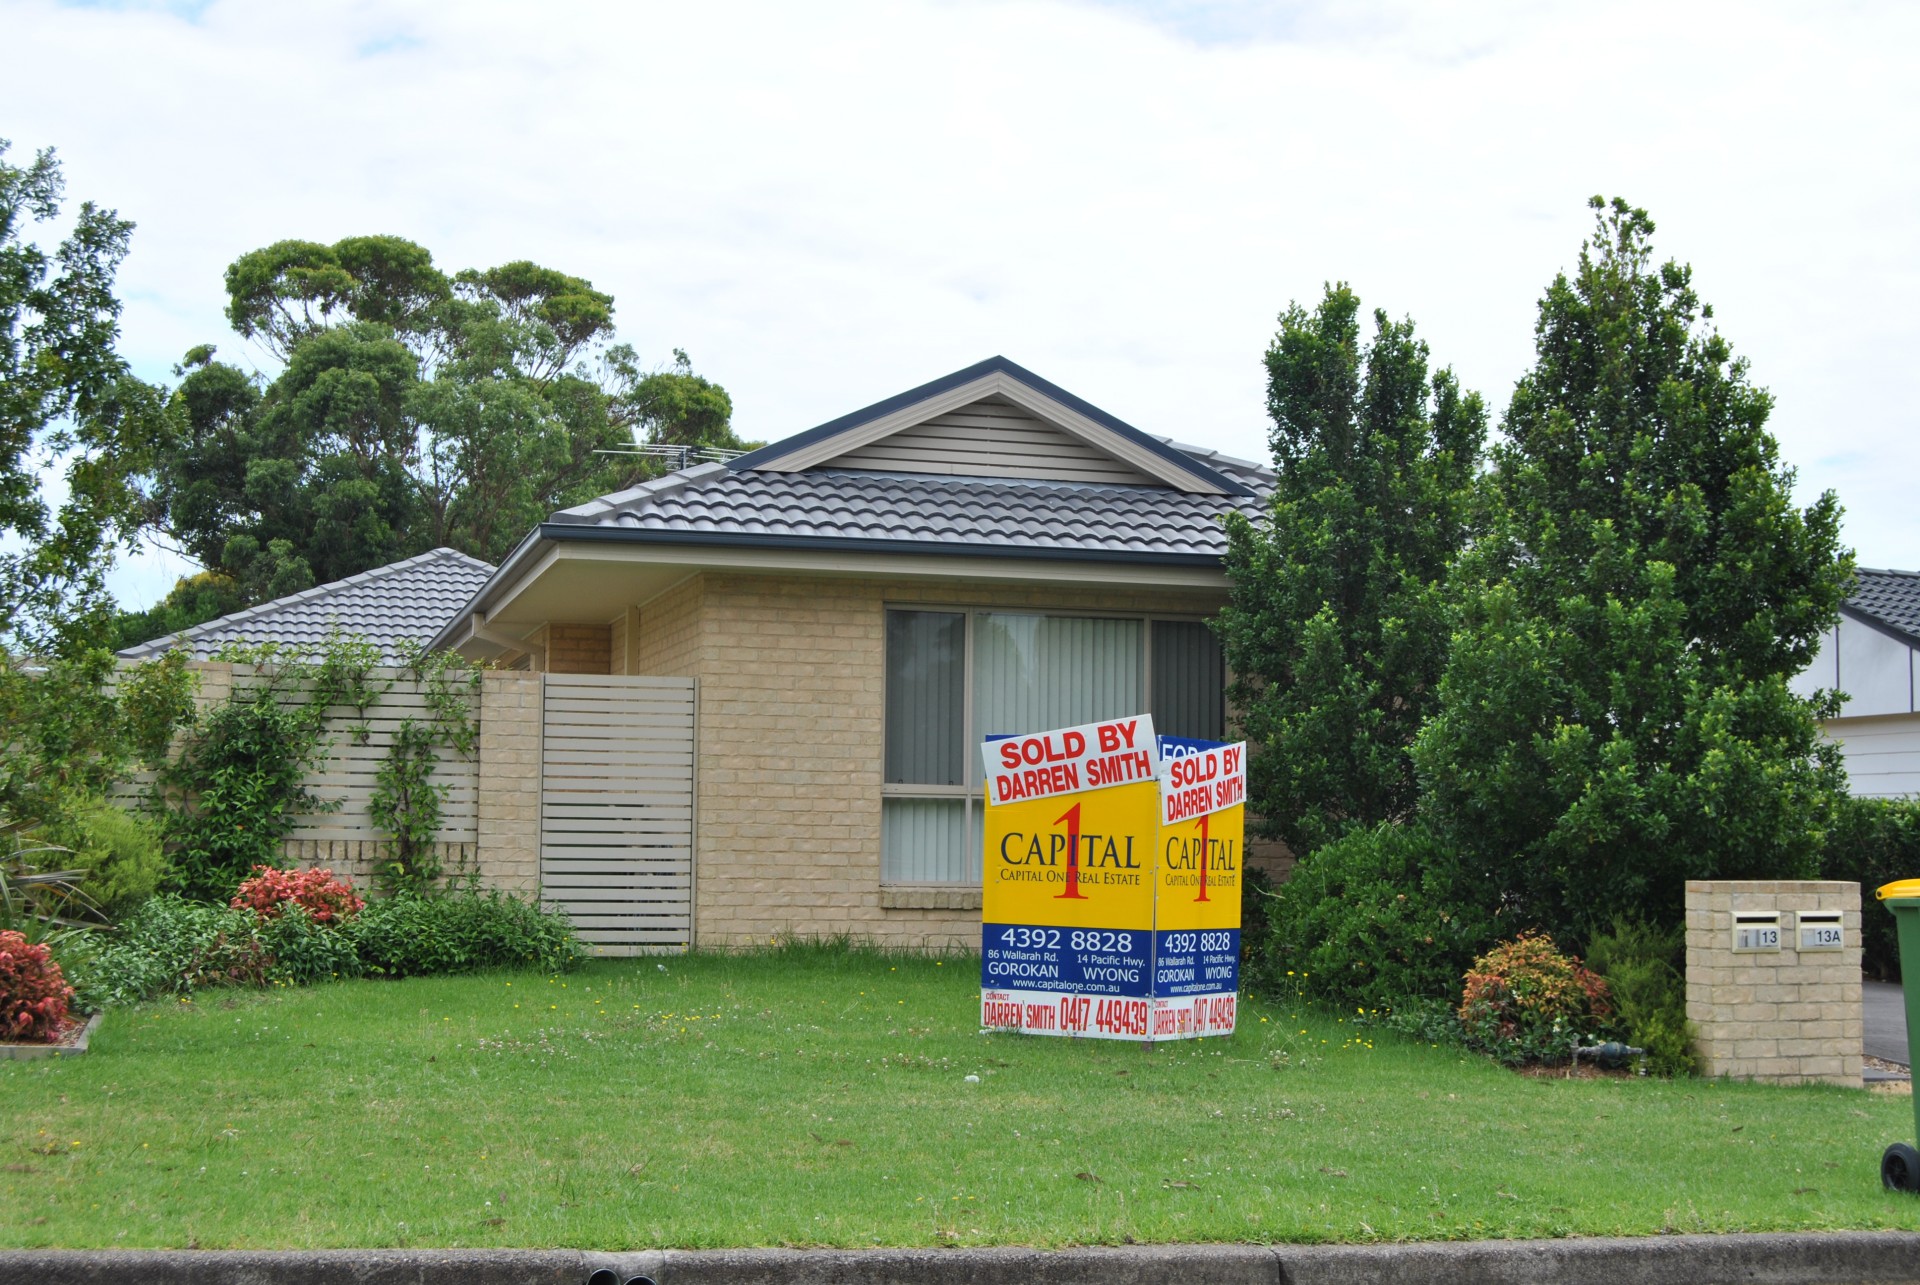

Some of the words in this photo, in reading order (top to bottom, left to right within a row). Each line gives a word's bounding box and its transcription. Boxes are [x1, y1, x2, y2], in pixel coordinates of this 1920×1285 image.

[1000, 731, 1086, 769] SOLD
[1097, 720, 1137, 753] BY
[1170, 753, 1217, 789] SOLD
[1223, 746, 1241, 776] BY
[996, 762, 1080, 802] DARREN
[1085, 750, 1152, 787] SMITH
[1167, 784, 1213, 822] DARREN
[1216, 774, 1243, 807] SMITH
[1000, 832, 1141, 869] CAPITAL
[1166, 836, 1235, 871] CAPITAL
[1000, 868, 1043, 882] CAPITAL
[1075, 871, 1100, 884] REAL
[1103, 872, 1140, 886] ESTATE
[1001, 928, 1061, 949] 4392
[1070, 931, 1132, 953] 8828
[1165, 933, 1197, 953] 4392
[1200, 932, 1231, 952] 8828
[1762, 930, 1778, 943] 13
[1816, 929, 1841, 943] 13A
[988, 949, 1000, 959] 86
[1002, 950, 1041, 962] Wallarah
[1043, 952, 1059, 962] Rd.
[1077, 954, 1088, 964] 14
[1091, 955, 1120, 965] Pacific
[1123, 957, 1146, 968] Hwy.
[1158, 957, 1164, 966] 86
[1203, 956, 1209, 965] 14
[1209, 954, 1224, 964] Pacific
[988, 962, 1059, 978] GOROKAN
[1083, 967, 1140, 983] WYONG
[1157, 968, 1195, 983] GOROKAN
[1205, 965, 1233, 980] WYONG
[1012, 980, 1120, 993] www.capitalone.com.au
[1170, 982, 1222, 993] www.capitalone.com.au
[985, 992, 1010, 1001] CONTACT
[984, 1001, 1023, 1028] DARREN
[1026, 1004, 1056, 1030] SMITH
[1060, 997, 1091, 1032] 0417
[1095, 999, 1148, 1036] 449439
[1153, 1009, 1176, 1036] DARREN
[1209, 997, 1234, 1030] 449439
